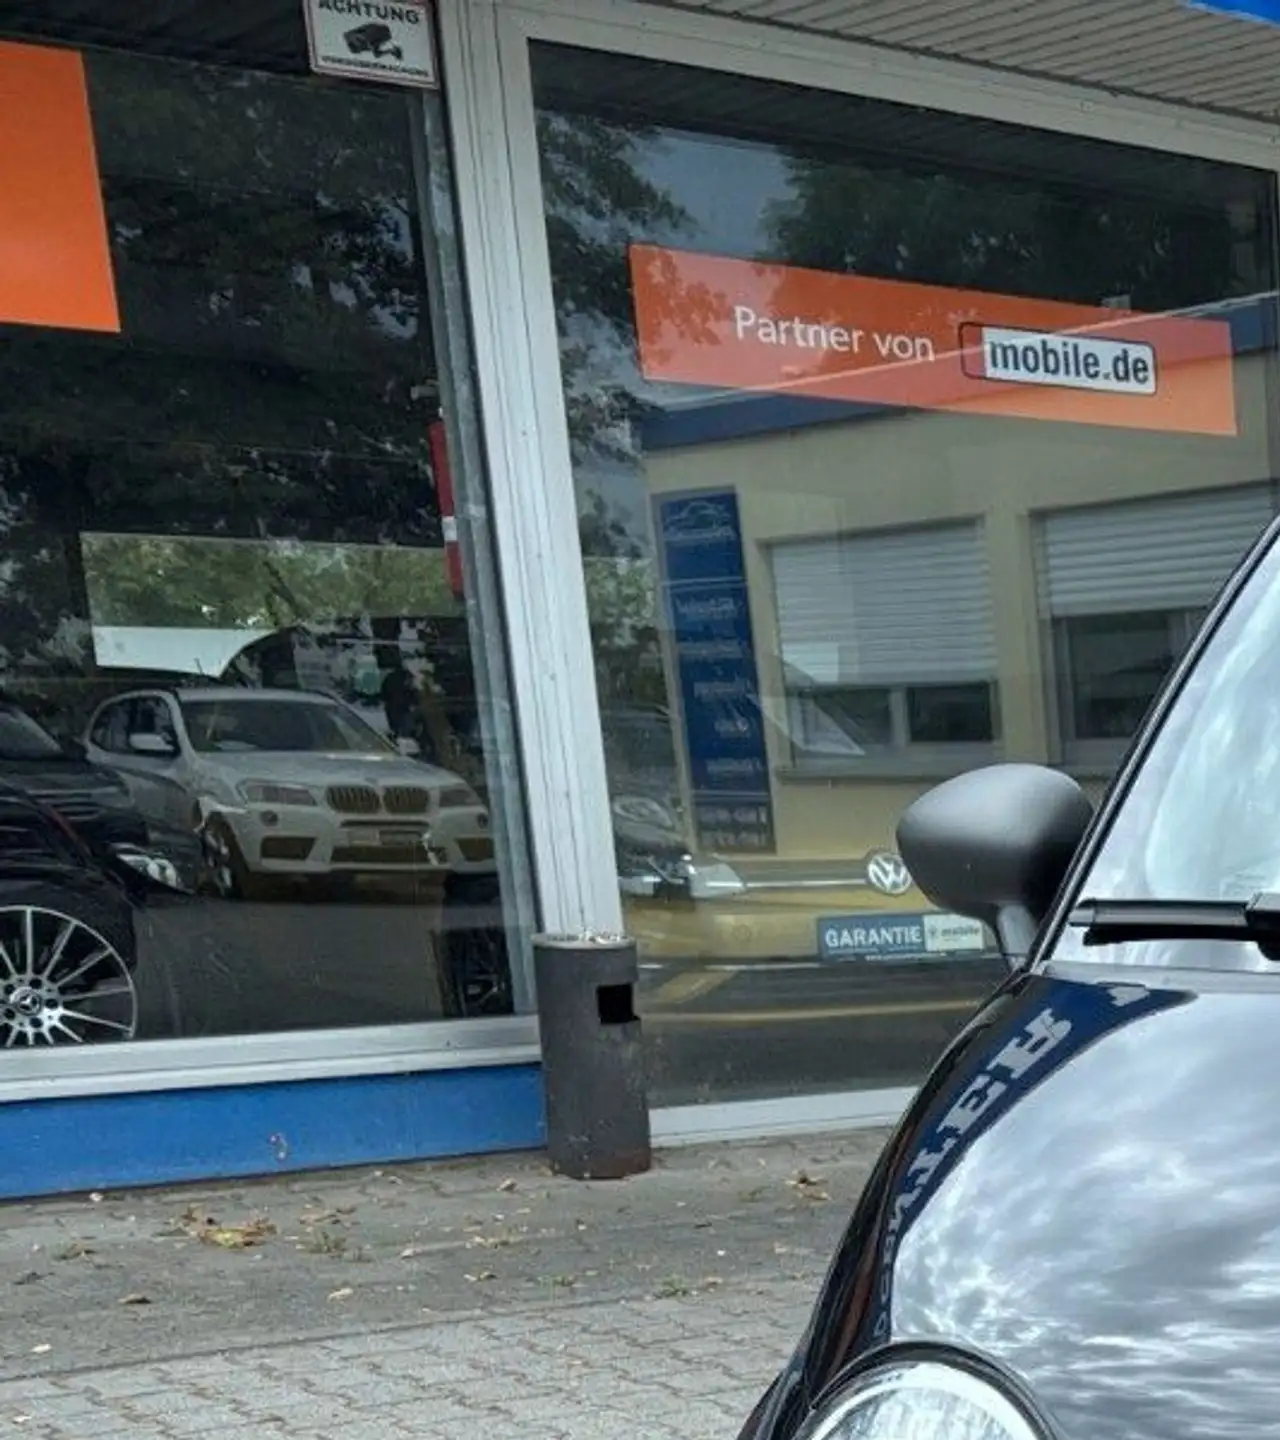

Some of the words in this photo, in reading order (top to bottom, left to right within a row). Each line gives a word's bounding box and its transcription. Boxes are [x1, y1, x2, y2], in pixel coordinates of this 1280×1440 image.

[318, 0, 420, 24] ACHTUNG
[734, 305, 864, 354] Partner
[872, 332, 936, 363] von
[988, 339, 1151, 385] mobile.de
[824, 925, 923, 949] GARANTIE
